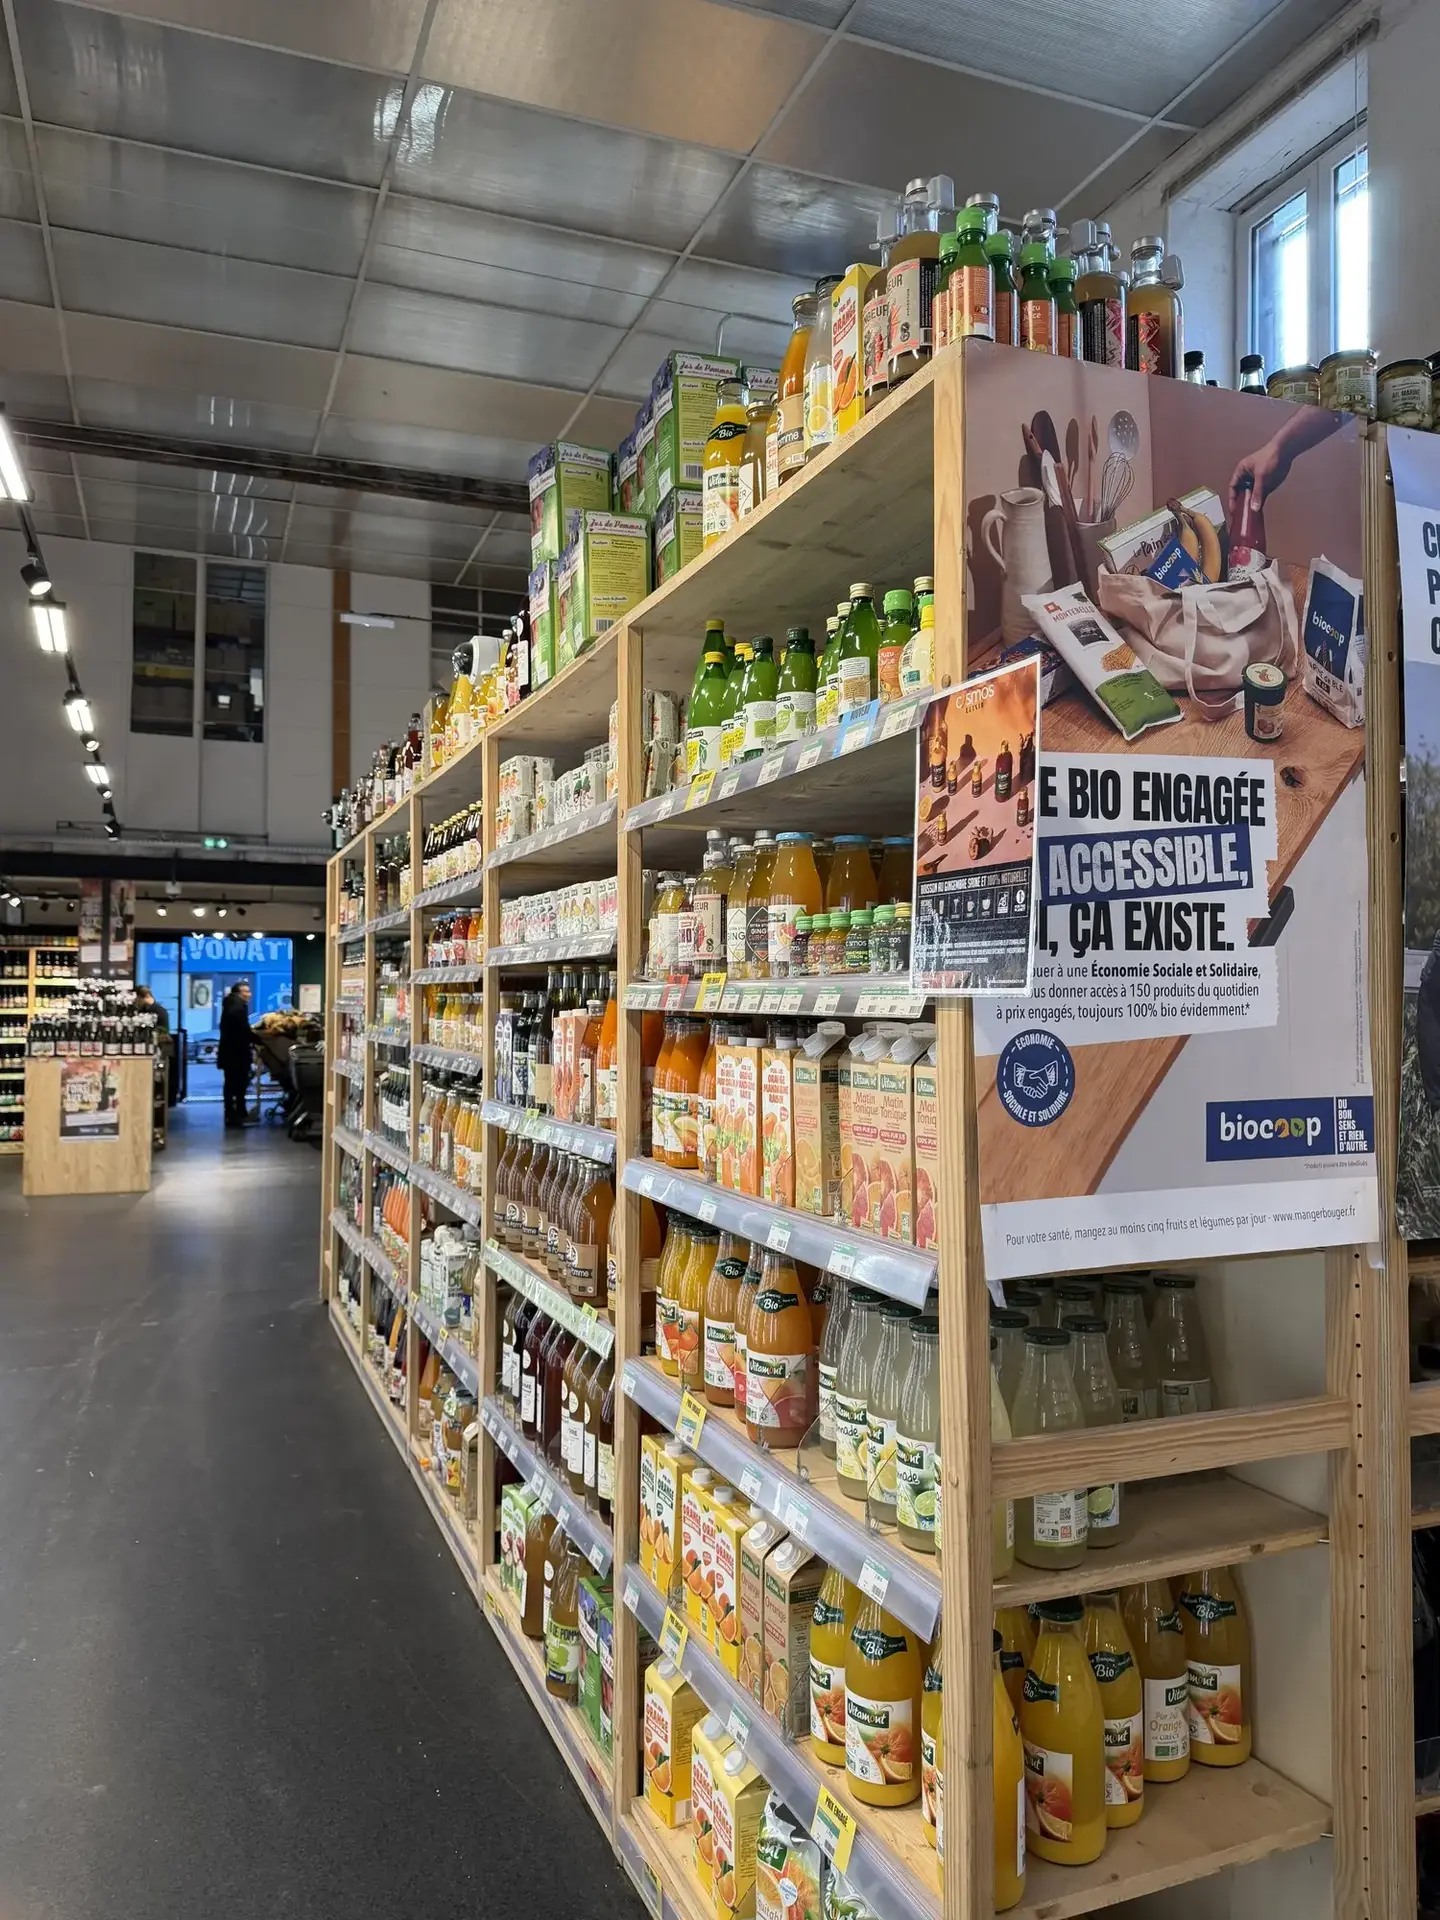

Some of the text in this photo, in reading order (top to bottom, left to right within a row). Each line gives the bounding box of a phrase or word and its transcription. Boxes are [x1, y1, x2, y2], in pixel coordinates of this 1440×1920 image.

[704, 363, 734, 376] Pommes
[719, 429, 733, 438] Bio
[614, 520, 643, 531] Pommes
[1141, 538, 1164, 556] Pain
[1154, 548, 1181, 580] biocoop
[1052, 606, 1095, 622] MONTEBELLO
[1312, 611, 1345, 646] biocoop
[1068, 768, 1121, 820] BIO
[1133, 771, 1266, 826] ENGAGÉE
[1049, 833, 1249, 896] ACCESSIBLE,
[1070, 902, 1113, 958] ÇA
[1124, 901, 1235, 951] EXISTE.
[1057, 963, 1064, 978] à
[1067, 966, 1088, 978] une
[1091, 962, 1150, 978] Économie
[1153, 963, 1193, 978] Sociale
[1195, 965, 1208, 977] et
[1209, 963, 1261, 979] Solidaire,
[1048, 983, 1088, 998] donner
[1090, 984, 1118, 998] accès
[1121, 983, 1127, 997] à
[1129, 984, 1150, 997] 150
[1153, 982, 1194, 1000] produits
[1197, 983, 1212, 997] du
[1213, 983, 1259, 999] quotidien
[996, 1004, 1003, 1019] à
[1005, 1005, 1026, 1023] prix
[1028, 1004, 1075, 1023] engagés,
[1077, 1004, 1124, 1022] toujours
[1126, 1003, 1158, 1019] 100%
[1160, 1003, 1178, 1018] bio
[1015, 1032, 1055, 1050] ÉCONOMIE
[856, 1091, 876, 1103] Matin
[883, 1095, 903, 1108] Matin
[1338, 1099, 1348, 1109] DU
[853, 1102, 879, 1116] Tonique
[880, 1106, 908, 1121] Tonique
[1003, 1089, 1069, 1123] SOCIALE ET SOLIDAIRE
[1338, 1109, 1352, 1120] BON
[1220, 1111, 1321, 1146] biocoop
[1338, 1120, 1356, 1130] SENS
[1339, 1130, 1364, 1141] ET RIEN
[1339, 1140, 1368, 1152] D'AUTRE
[1006, 1234, 1025, 1247] Pour
[1026, 1232, 1046, 1244] votre
[1048, 1228, 1072, 1242] santé,
[1074, 1227, 1106, 1241] mangez
[1108, 1226, 1117, 1236] au
[1119, 1222, 1145, 1235] moins
[1147, 1220, 1164, 1235] cinq
[1166, 1218, 1188, 1231] fruits
[1189, 1218, 1199, 1229] et
[1199, 1215, 1235, 1231] légumes
[1236, 1214, 1249, 1228] par
[1250, 1212, 1266, 1227] jour
[1272, 1204, 1356, 1223] www.mangerbouger.fr
[725, 1265, 739, 1276] Bio
[764, 1298, 778, 1310] Bio
[749, 1356, 784, 1377] Vitamont
[658, 1480, 674, 1500] ORANGE
[716, 1543, 734, 1566] ORANGE
[1196, 1604, 1214, 1619] Bio
[866, 1641, 883, 1656] Bio
[1094, 1664, 1114, 1678] Bio
[645, 1703, 668, 1734] ORANGE
[848, 1700, 886, 1725] Vitamont
[1150, 1719, 1182, 1734] Orange
[825, 1795, 848, 1827] PRIX ENGAGÉ
